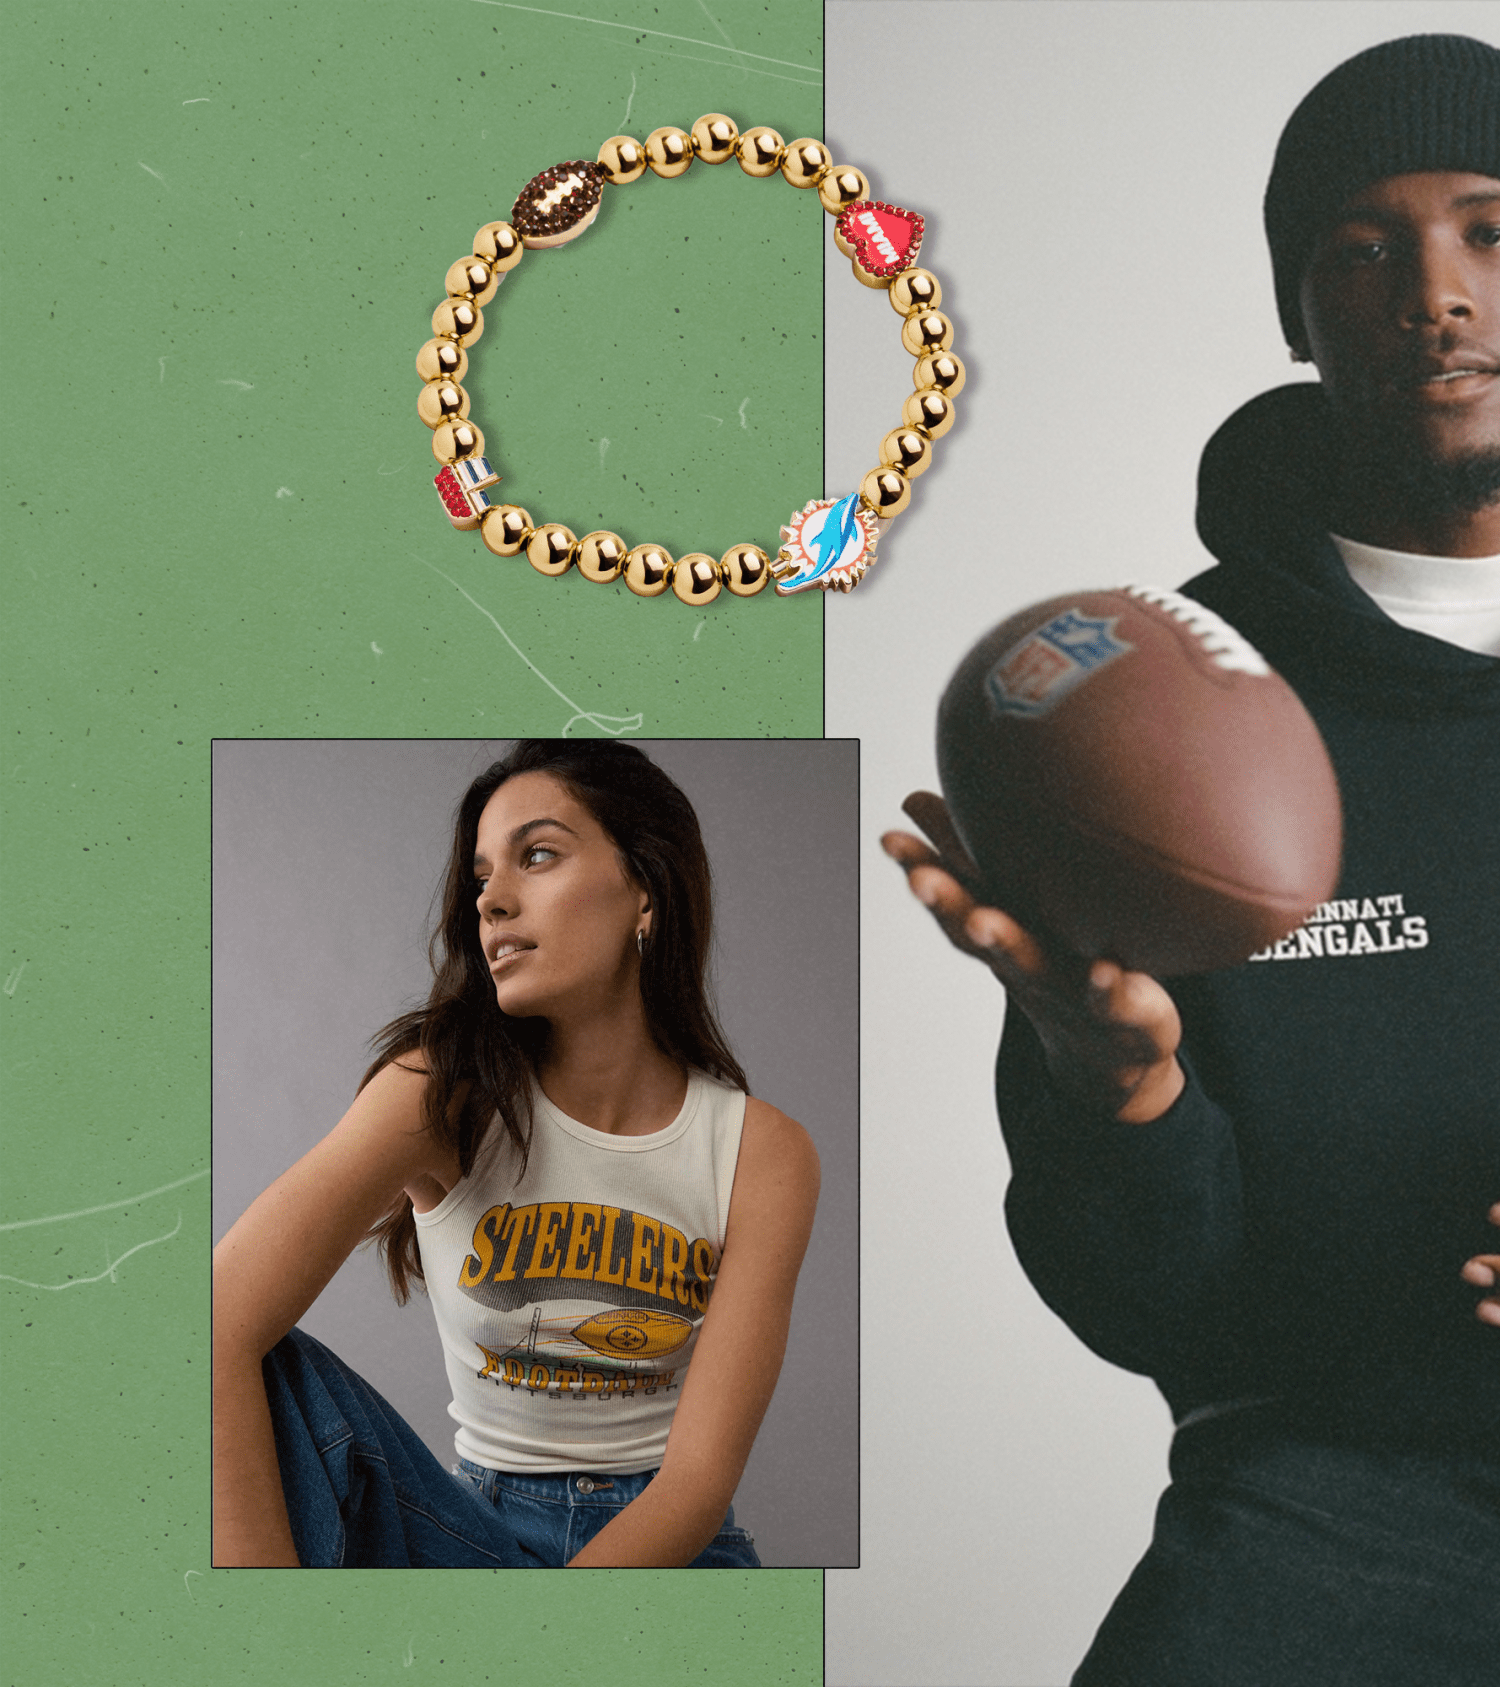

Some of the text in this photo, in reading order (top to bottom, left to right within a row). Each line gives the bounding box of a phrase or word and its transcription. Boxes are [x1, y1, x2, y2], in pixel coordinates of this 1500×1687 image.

[857, 211, 900, 264] MIAMI
[1303, 894, 1405, 924] INNATI
[457, 1202, 715, 1315] STEELERS
